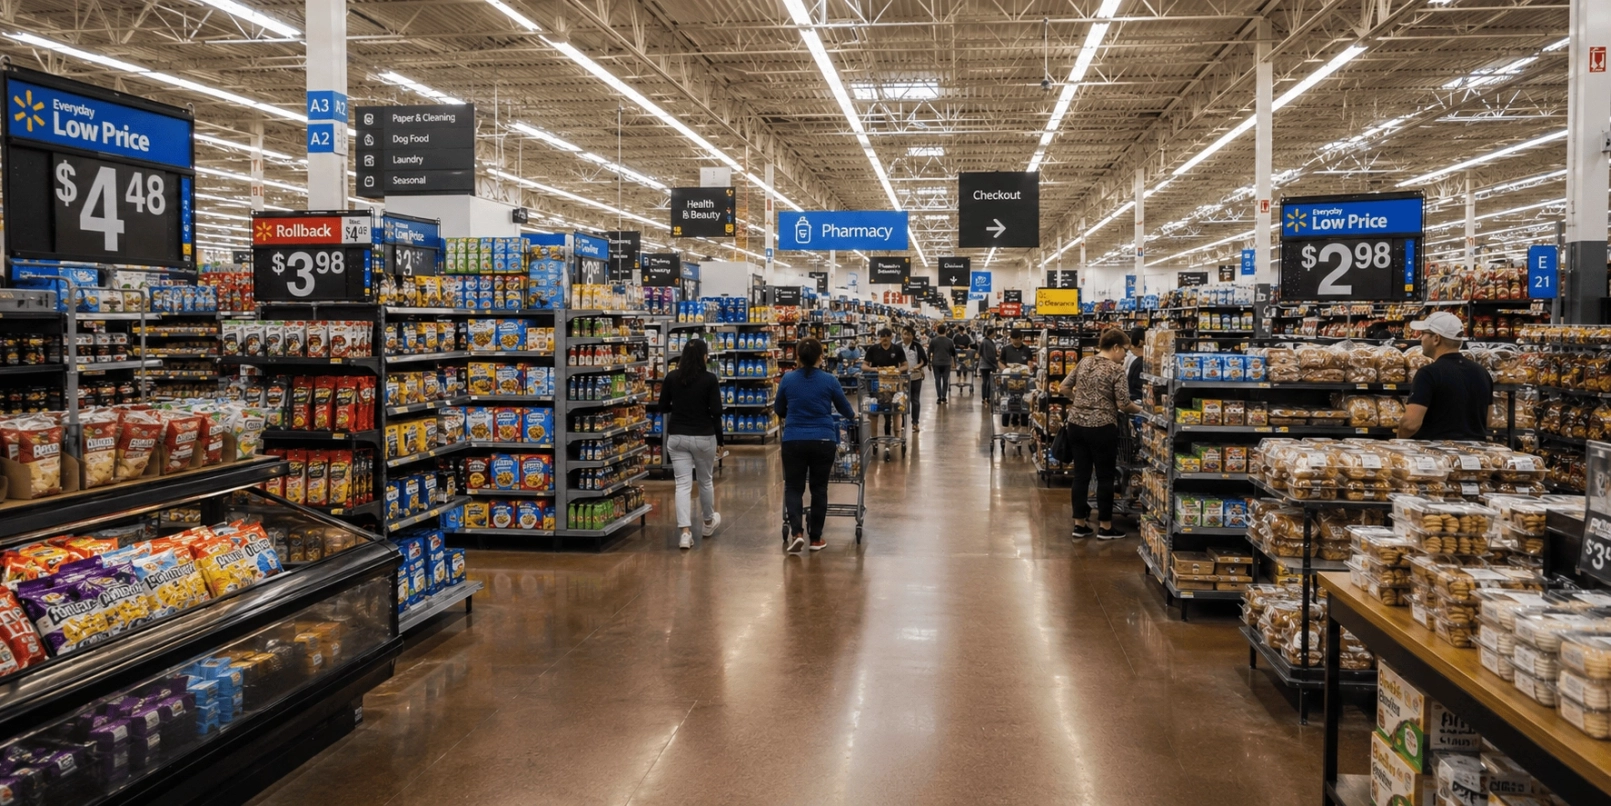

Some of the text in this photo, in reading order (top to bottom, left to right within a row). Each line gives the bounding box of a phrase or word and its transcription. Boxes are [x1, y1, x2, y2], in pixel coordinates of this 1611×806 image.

[53, 99, 95, 119] Everyday
[310, 98, 330, 113] A3
[335, 100, 346, 116] A2
[392, 113, 456, 124] Paper & Cleaning
[53, 111, 150, 152] Low Price
[310, 131, 330, 146] A2
[392, 134, 429, 145] Dog Food
[392, 155, 424, 165] Laundry
[392, 176, 426, 185] Seasonal
[973, 190, 1021, 201] Checkout
[687, 199, 714, 209] Health
[690, 210, 721, 221] Beauty
[1312, 207, 1343, 216] Everyday
[1312, 213, 1388, 230] Low Price
[276, 223, 332, 238] Rollback
[822, 223, 893, 241] Pharmacy
[1538, 255, 1548, 269] E
[1534, 275, 1550, 288] 21
